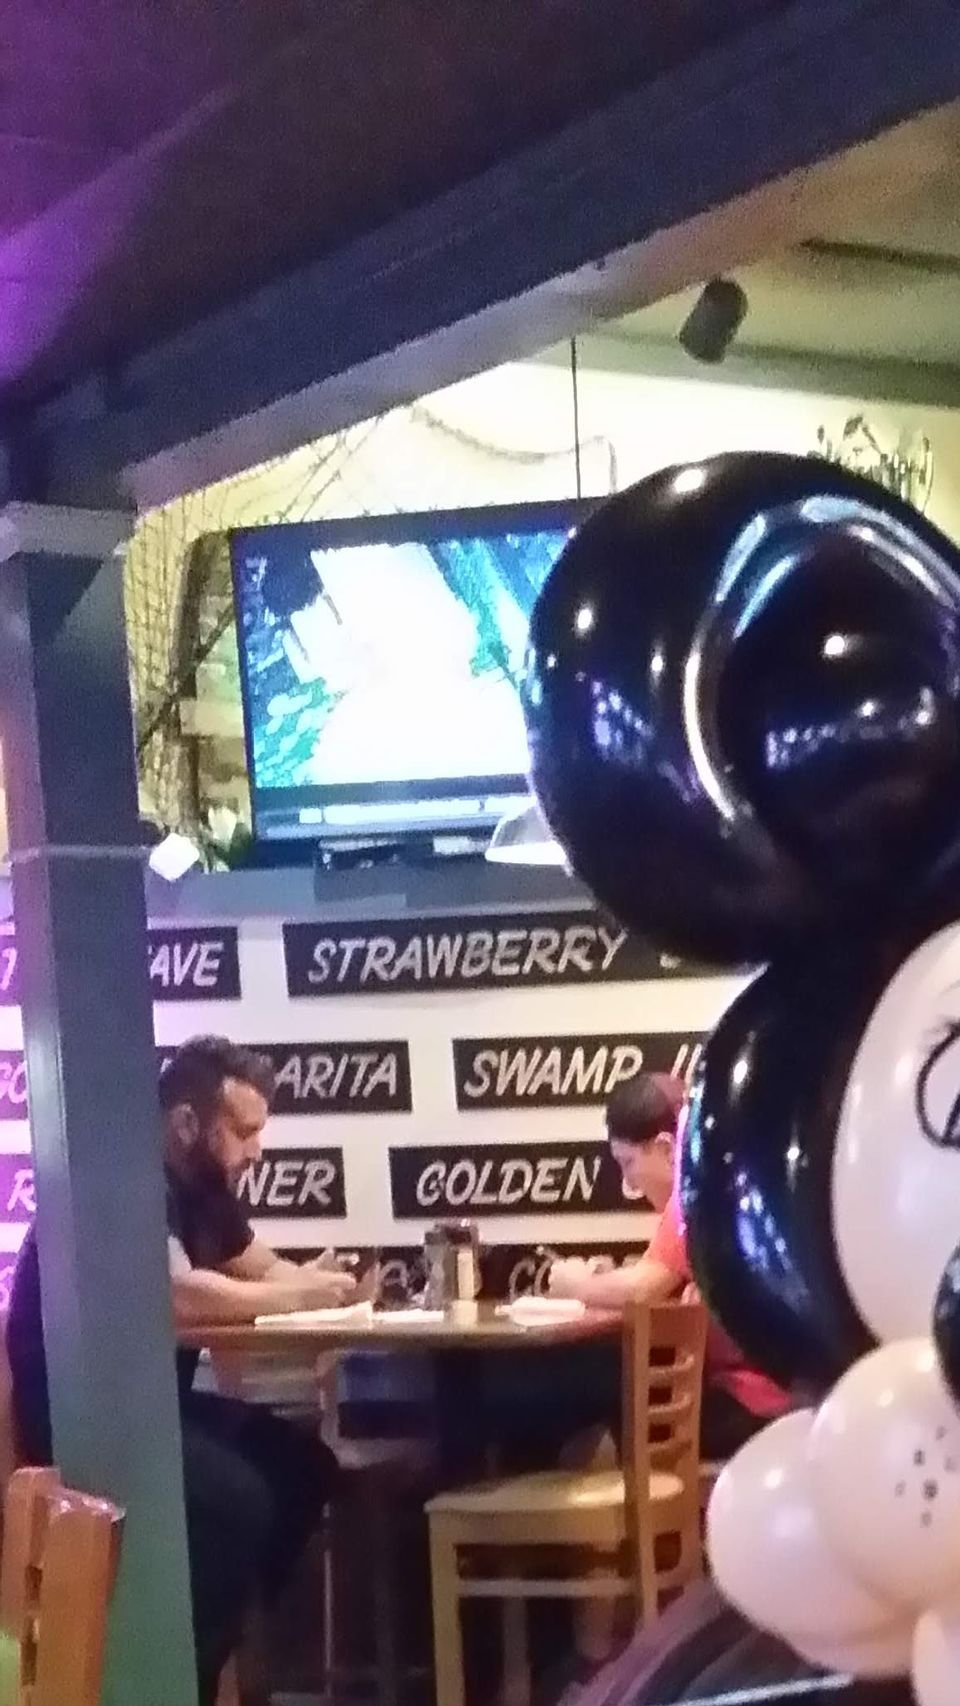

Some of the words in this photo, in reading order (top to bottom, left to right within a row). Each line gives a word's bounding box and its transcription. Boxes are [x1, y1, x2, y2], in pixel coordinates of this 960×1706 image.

[148, 941, 225, 987] AVE
[308, 925, 628, 985] STRAWBERRY
[274, 1053, 398, 1099] ARITA
[463, 1044, 644, 1098] SWAMP
[236, 1159, 336, 1207] NER
[415, 1154, 601, 1207] GOLDEN
